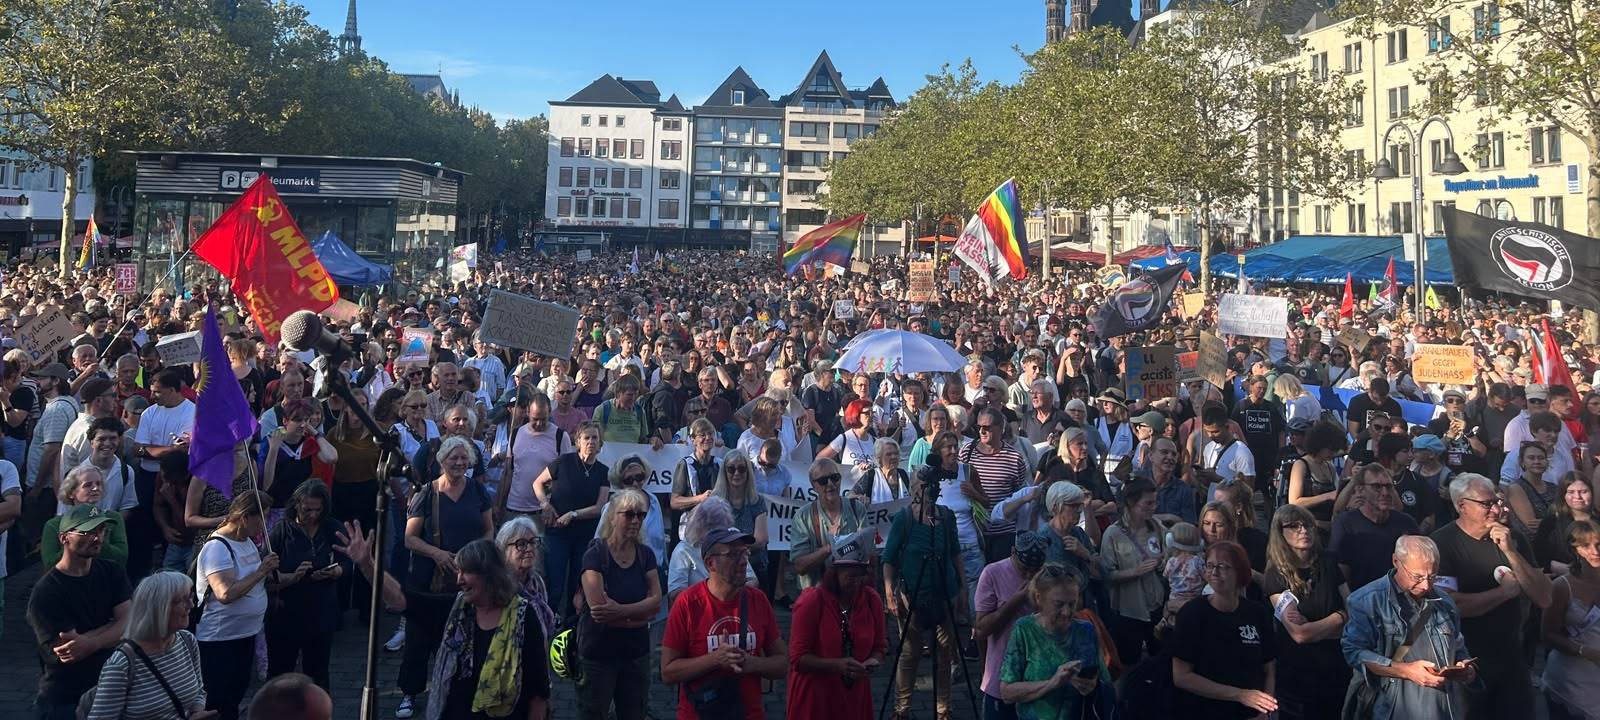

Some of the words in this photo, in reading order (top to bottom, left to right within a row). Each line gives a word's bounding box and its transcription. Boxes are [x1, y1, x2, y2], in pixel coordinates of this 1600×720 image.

[963, 231, 985, 253] KEIN
[270, 225, 334, 302] MLPD
[647, 470, 672, 486] AS
